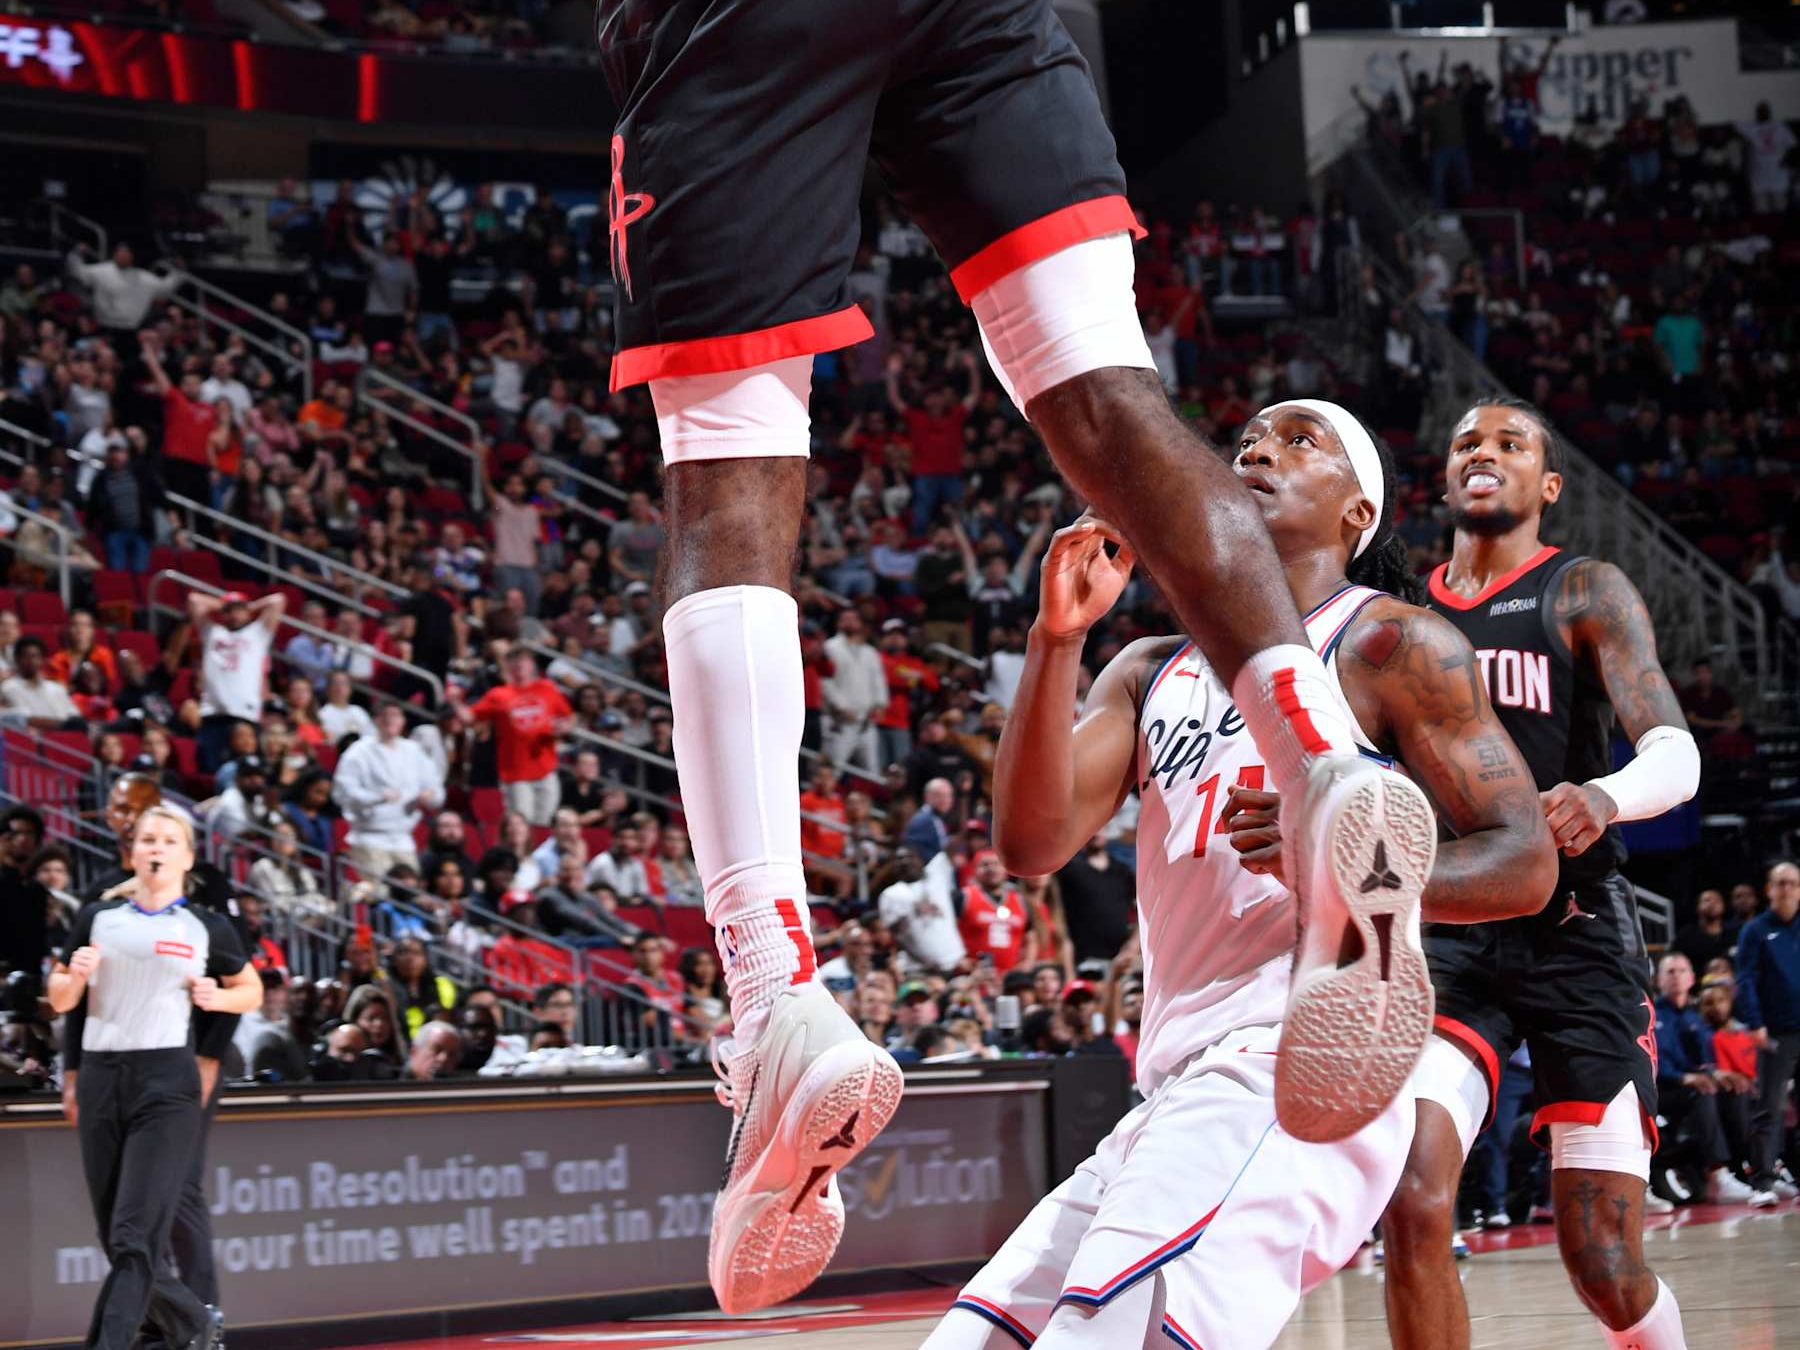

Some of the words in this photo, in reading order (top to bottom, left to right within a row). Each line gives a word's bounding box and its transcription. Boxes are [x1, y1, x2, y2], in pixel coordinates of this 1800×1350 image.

[210, 1164, 299, 1216] Join
[554, 1144, 629, 1195] and
[304, 1219, 399, 1267] time
[408, 1206, 494, 1260] well
[503, 1201, 608, 1266] spent
[612, 1199, 651, 1244] in
[657, 1192, 717, 1240] 202
